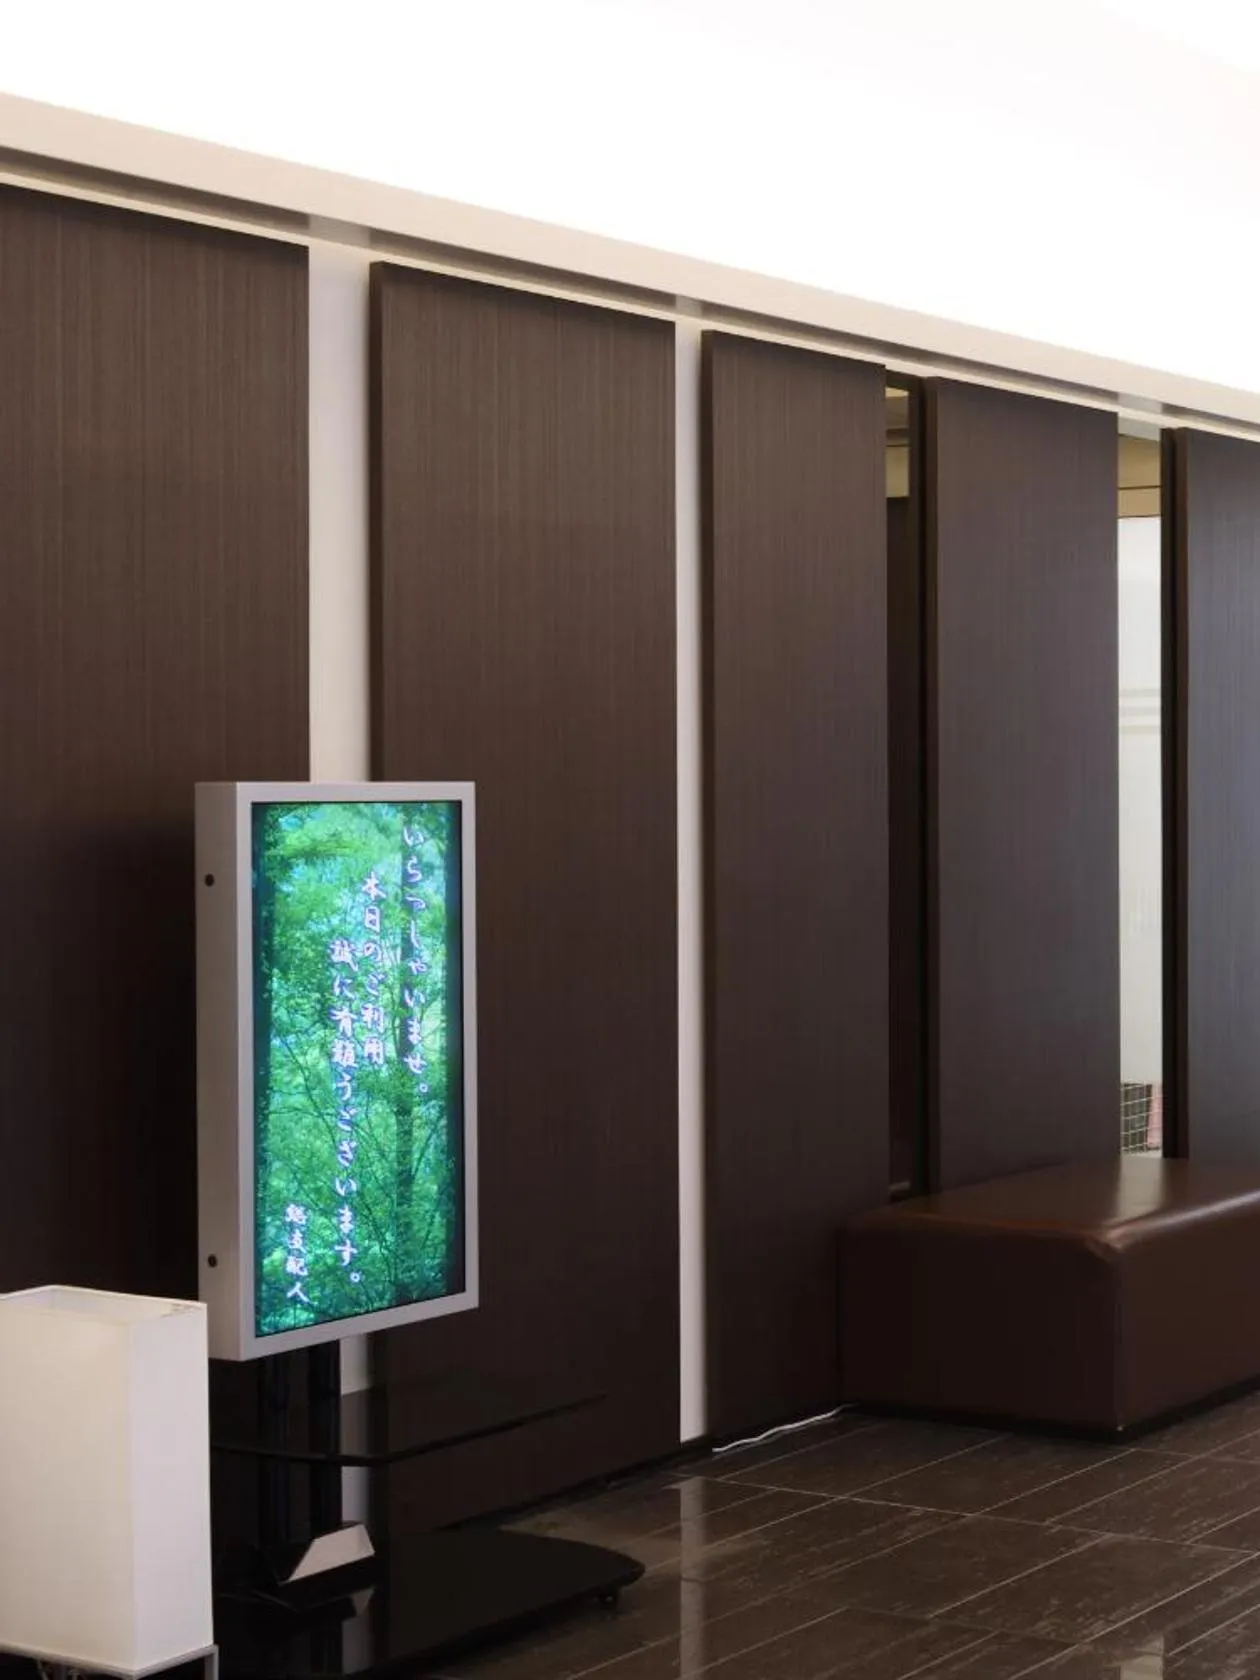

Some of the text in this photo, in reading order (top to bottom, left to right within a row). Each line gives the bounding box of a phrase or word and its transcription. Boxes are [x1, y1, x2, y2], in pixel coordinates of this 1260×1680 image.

[362, 871, 388, 1065] 本日のご利用
[403, 826, 428, 1093] いらっしゃいませ。
[328, 938, 361, 1283] 誠に有難うございます。
